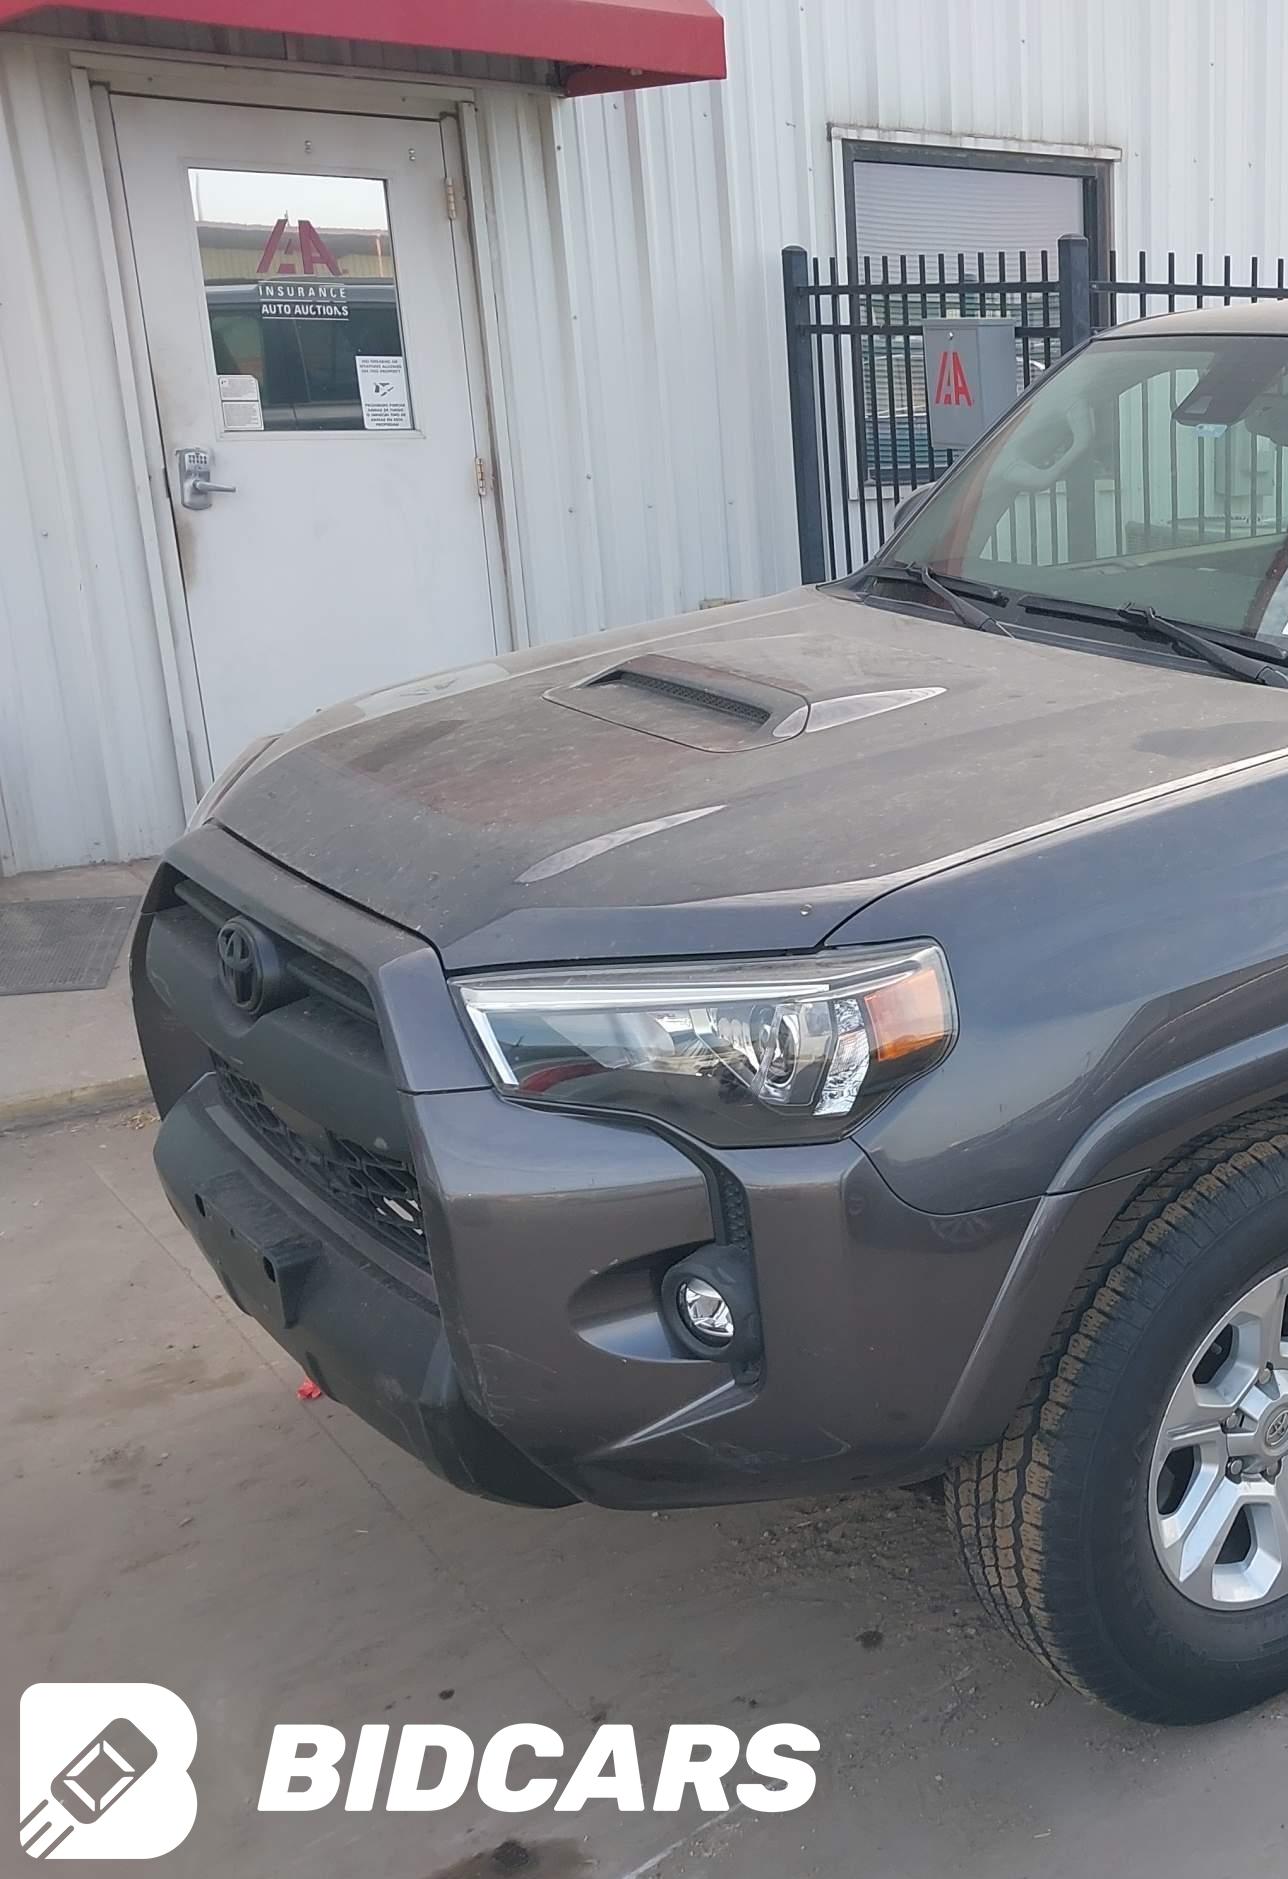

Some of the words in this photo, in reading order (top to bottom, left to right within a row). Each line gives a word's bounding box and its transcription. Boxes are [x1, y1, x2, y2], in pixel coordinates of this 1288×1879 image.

[258, 285, 347, 298] INSURANCE
[262, 303, 291, 315] AUTO
[294, 304, 349, 316] AUCTIONS
